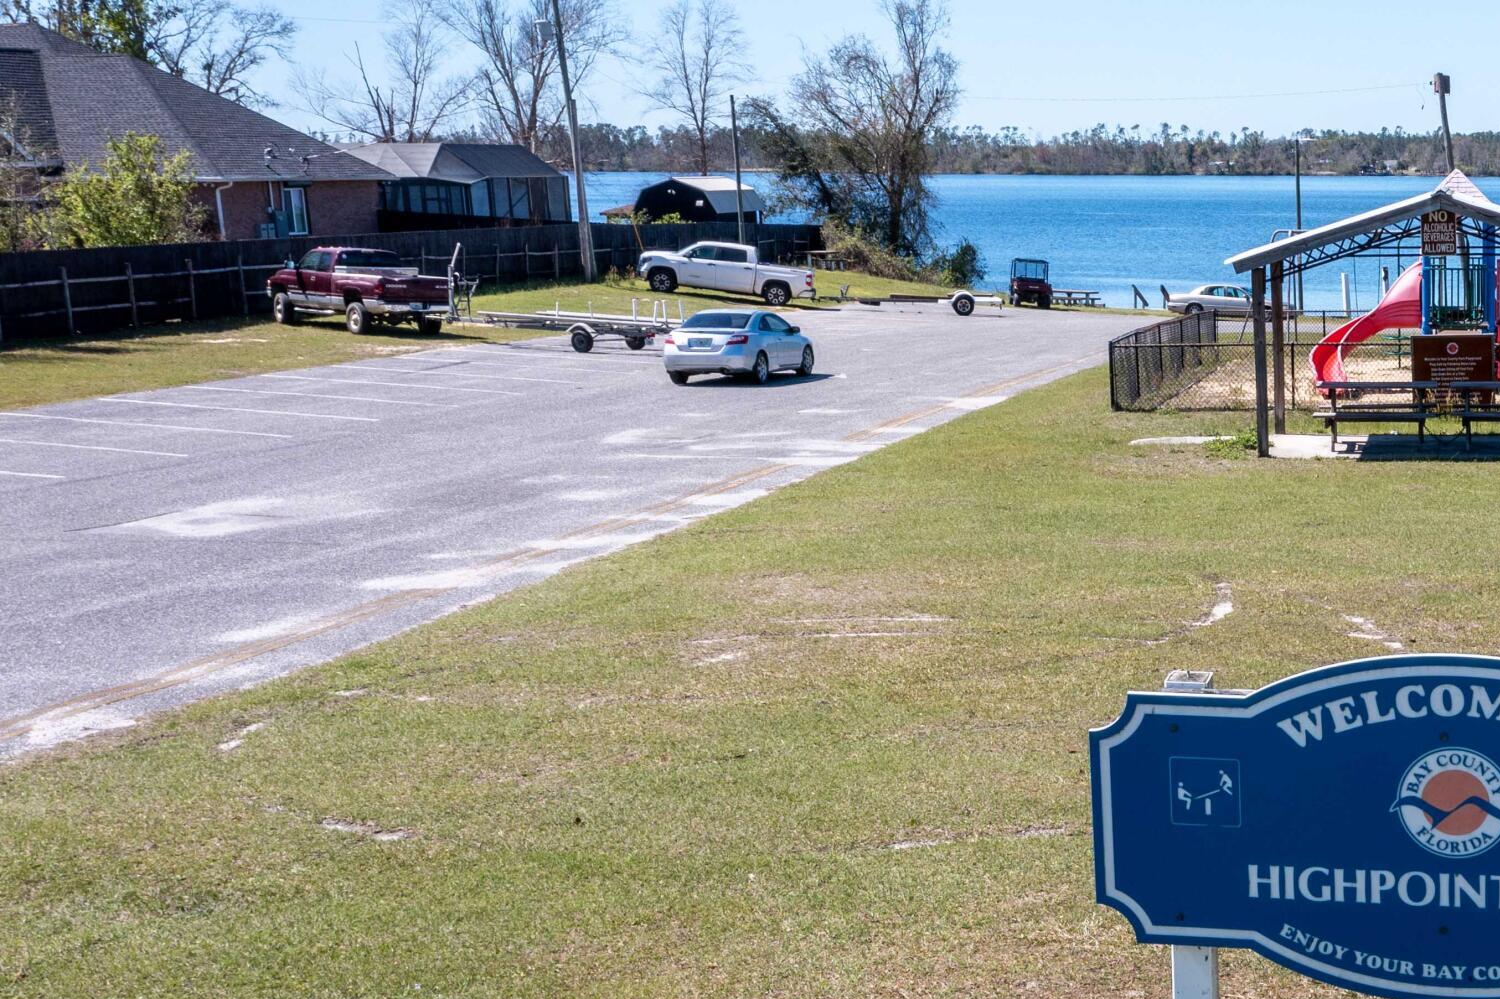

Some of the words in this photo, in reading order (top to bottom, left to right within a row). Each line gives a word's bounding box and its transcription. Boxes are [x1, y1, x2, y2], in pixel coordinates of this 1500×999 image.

[1429, 211, 1448, 222] NO
[1423, 222, 1455, 232] ALCOHOLIC
[1423, 232, 1455, 242] BEVERAGES
[1424, 243, 1455, 253] ALLOWED
[1406, 761, 1433, 794] BAY
[1416, 826, 1493, 853] FLORIDA
[1279, 923, 1349, 960] ENJOY
[1353, 950, 1415, 976] YOUR
[1422, 963, 1467, 980] BAY
